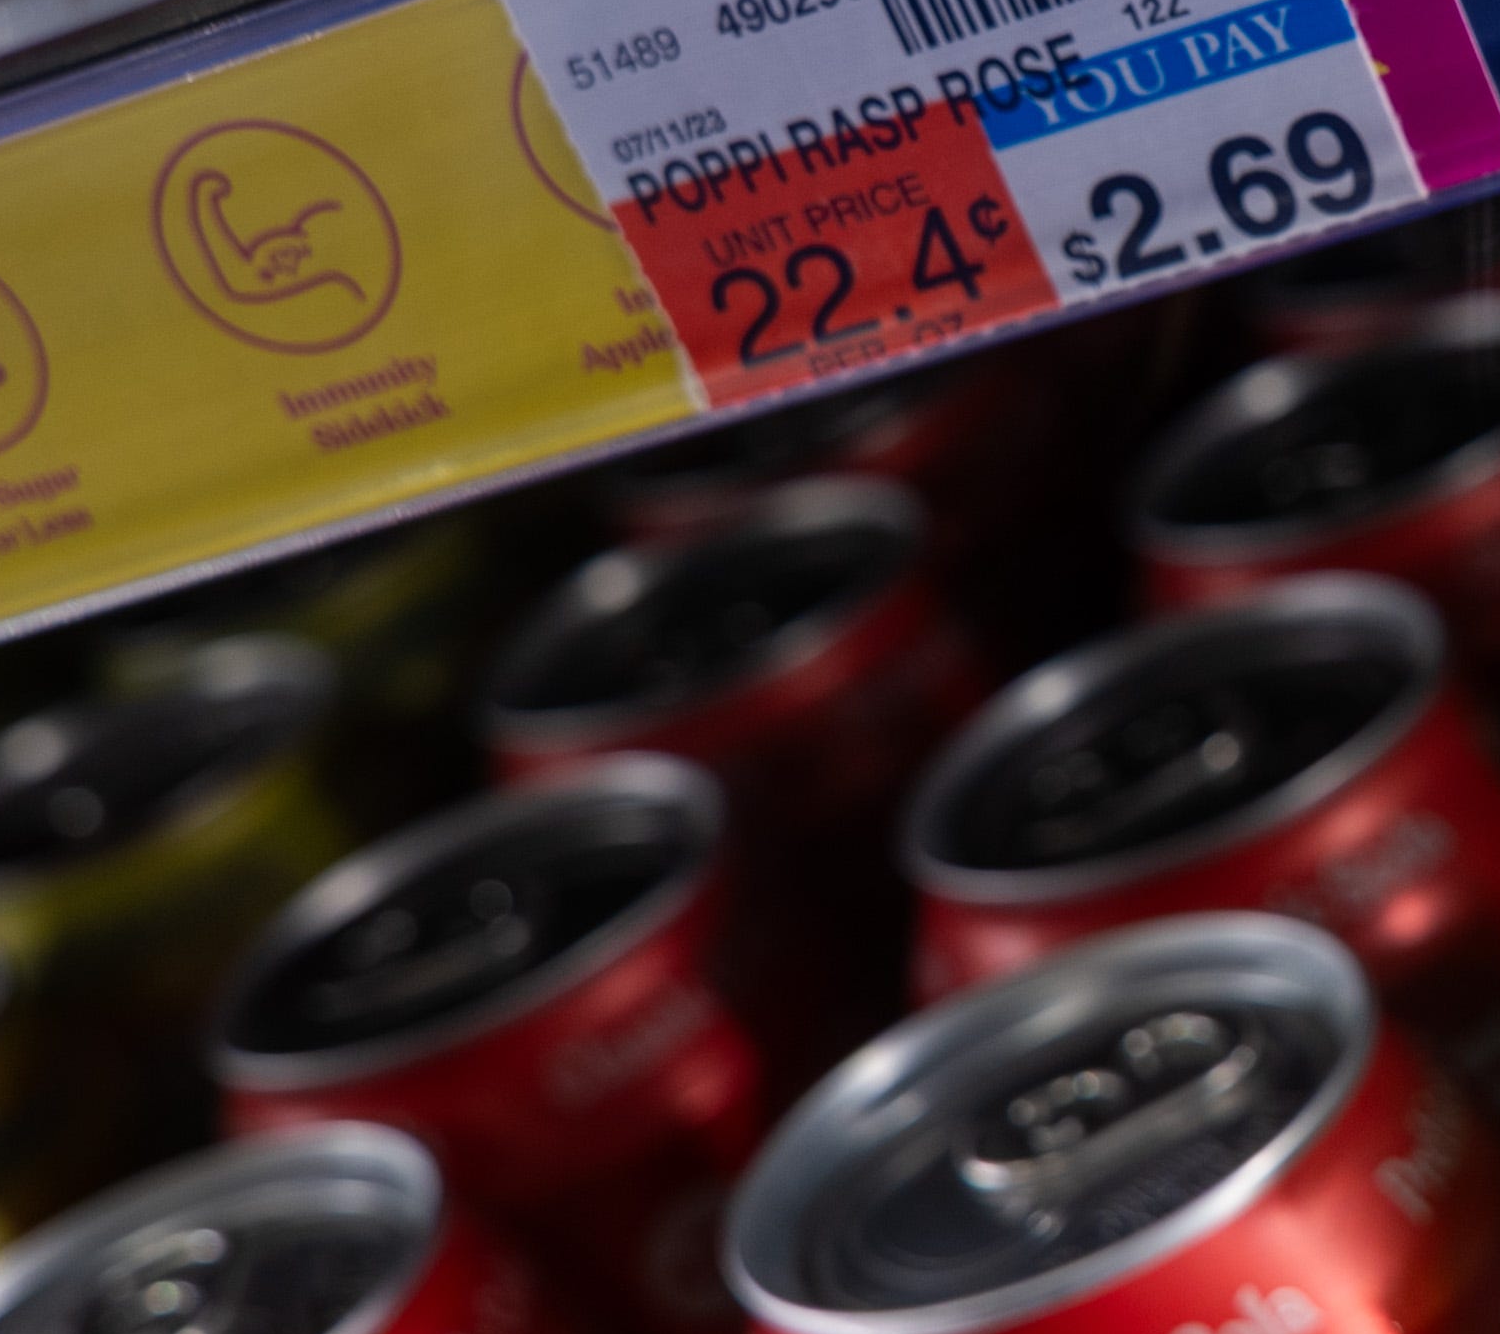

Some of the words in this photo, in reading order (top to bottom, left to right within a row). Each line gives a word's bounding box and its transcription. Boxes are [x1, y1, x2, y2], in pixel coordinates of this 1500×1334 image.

[565, 26, 683, 92] 51489
[1022, 46, 1168, 127] YOU
[1179, 3, 1294, 79] PAY
[612, 107, 729, 165] 07/11/23
[625, 132, 790, 228] POPPI
[786, 83, 927, 177] RASP
[936, 32, 1100, 127] ROSE
[700, 214, 794, 267] UNIT
[803, 171, 933, 237] PRICE
[1061, 108, 1377, 287] $2.69
[278, 352, 438, 422] Immunity
[310, 391, 453, 454] Sidekick
